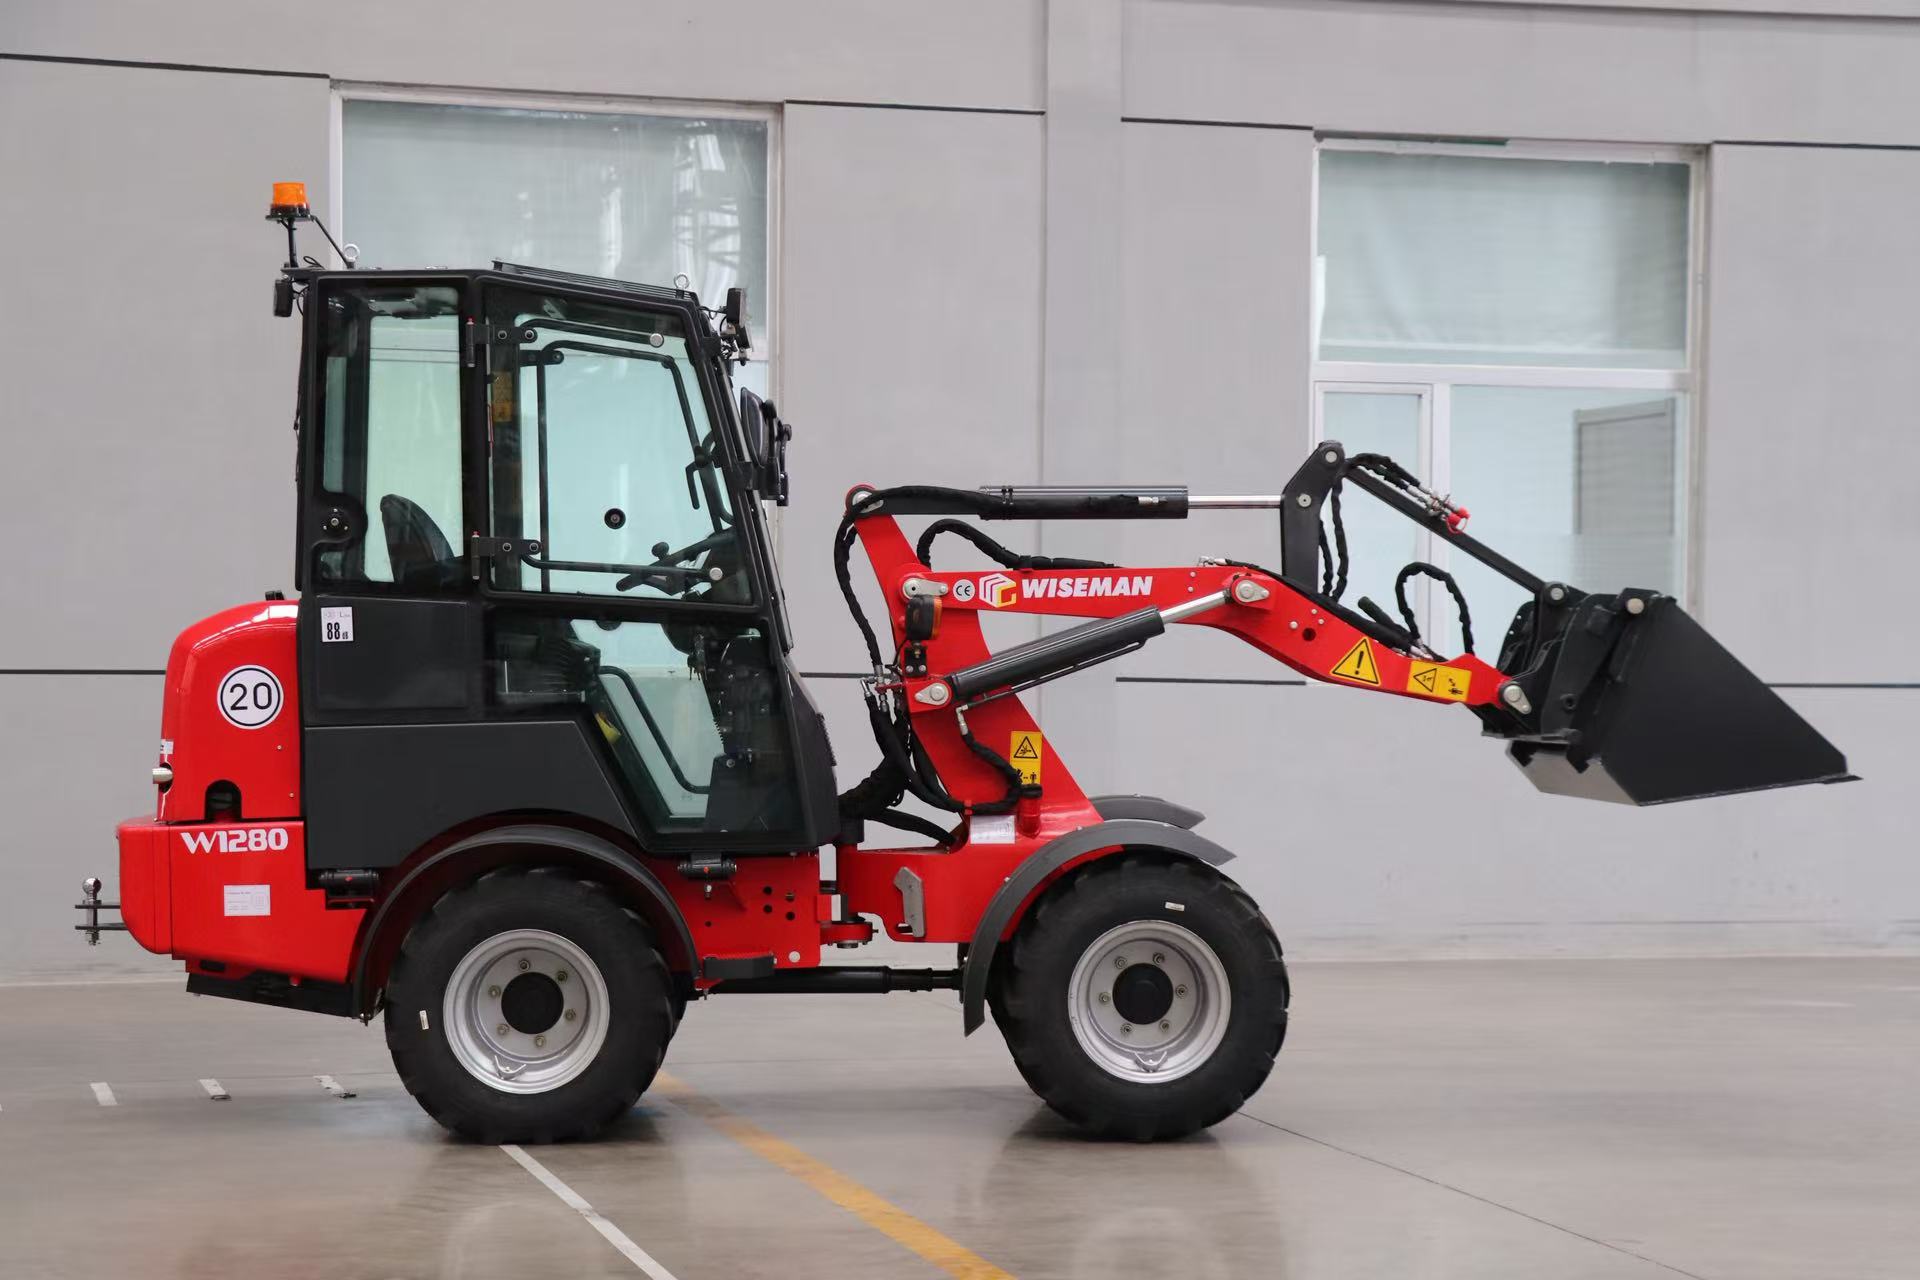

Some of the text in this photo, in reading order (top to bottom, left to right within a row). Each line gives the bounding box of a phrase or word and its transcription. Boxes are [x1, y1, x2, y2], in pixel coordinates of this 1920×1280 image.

[955, 584, 971, 597] CE
[1021, 575, 1153, 599] WISEMAN
[327, 622, 341, 640] 88
[229, 682, 273, 711] 20
[180, 827, 289, 854] W1280
